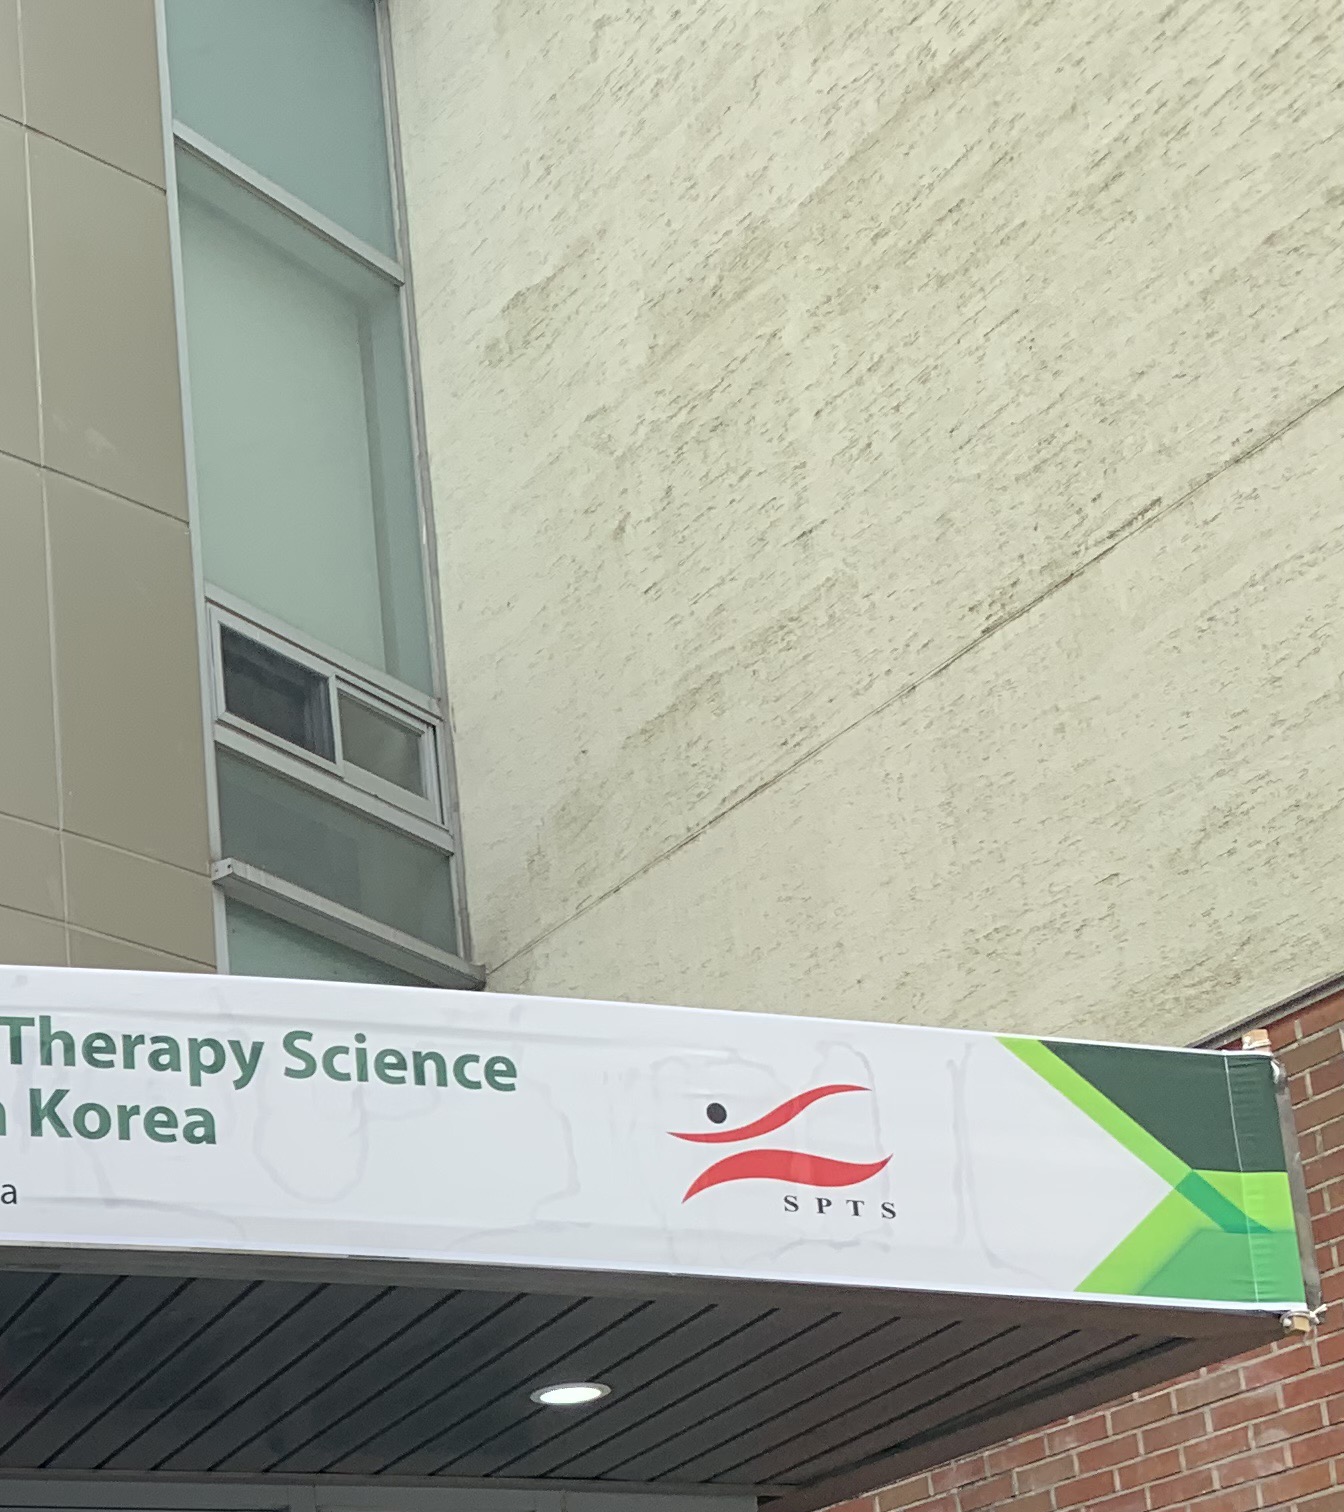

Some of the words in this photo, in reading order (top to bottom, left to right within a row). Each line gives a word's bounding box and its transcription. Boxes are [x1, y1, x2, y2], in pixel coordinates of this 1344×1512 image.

[282, 1030, 518, 1092] Science
[29, 1087, 217, 1145] Korea
[783, 1193, 897, 1220] SPTS
